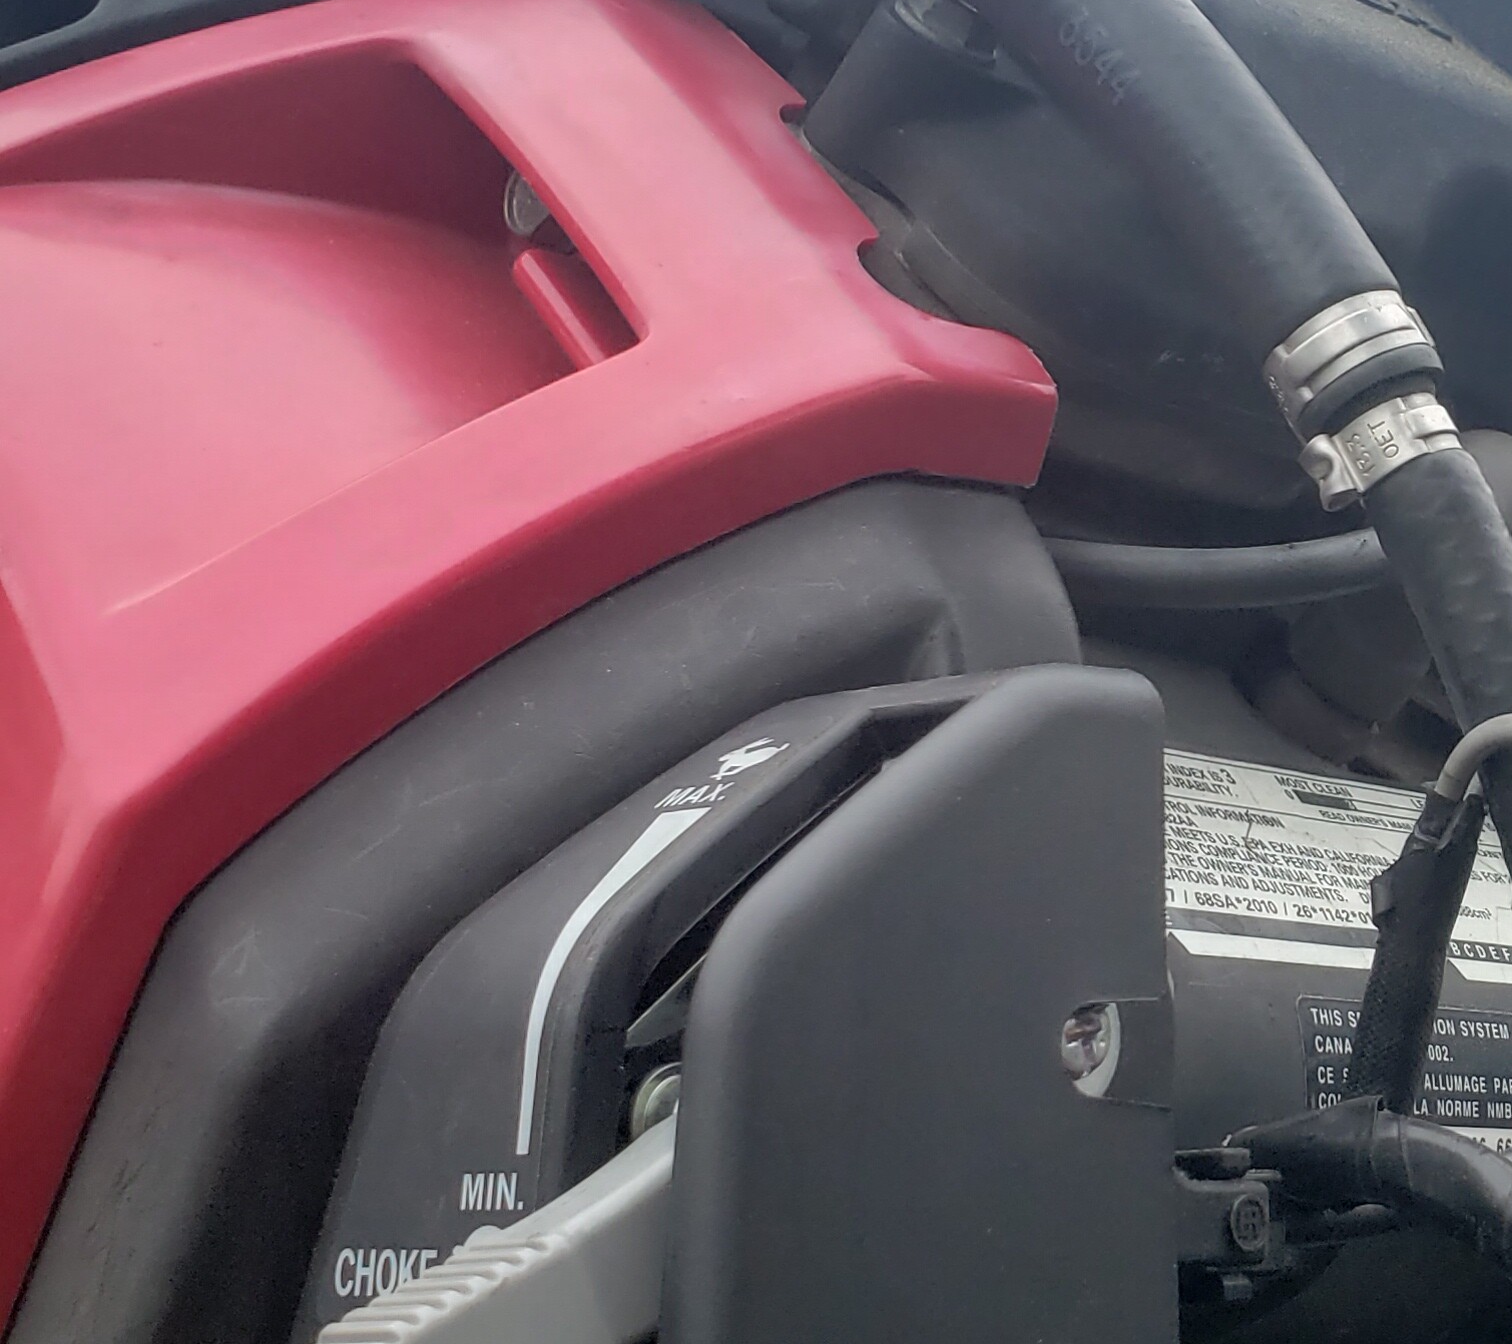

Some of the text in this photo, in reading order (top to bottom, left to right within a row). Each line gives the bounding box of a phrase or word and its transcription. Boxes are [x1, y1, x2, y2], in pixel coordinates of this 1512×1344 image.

[1167, 763, 1209, 780] INDEX
[1220, 768, 1236, 785] 3
[653, 781, 736, 809] MAX.
[1195, 805, 1286, 829] INFORMATION
[1168, 825, 1217, 844] MEETS
[1268, 841, 1298, 855] EXH
[1296, 845, 1325, 859] AND
[1197, 842, 1284, 866] COMPLIANCE
[1167, 851, 1198, 868] THE
[1197, 856, 1259, 877] OWNER'S
[1257, 864, 1317, 884] MANUAL
[1314, 873, 1342, 888] FOR
[1219, 874, 1249, 890] AND
[1450, 941, 1461, 957] B
[1463, 943, 1475, 958] C
[1475, 945, 1487, 960] D
[1488, 946, 1501, 962] E
[1501, 947, 1511, 963] F
[1309, 1007, 1343, 1027] THIS
[1460, 1020, 1509, 1040] SYSTEM
[1314, 1034, 1353, 1054] CANA
[1427, 1044, 1454, 1062] 002.
[1317, 1065, 1335, 1085] CE
[1423, 1072, 1488, 1094] ALLUMAGE
[1413, 1098, 1429, 1116] LA
[1437, 1099, 1480, 1118] NORME
[459, 1172, 525, 1212] MIN.
